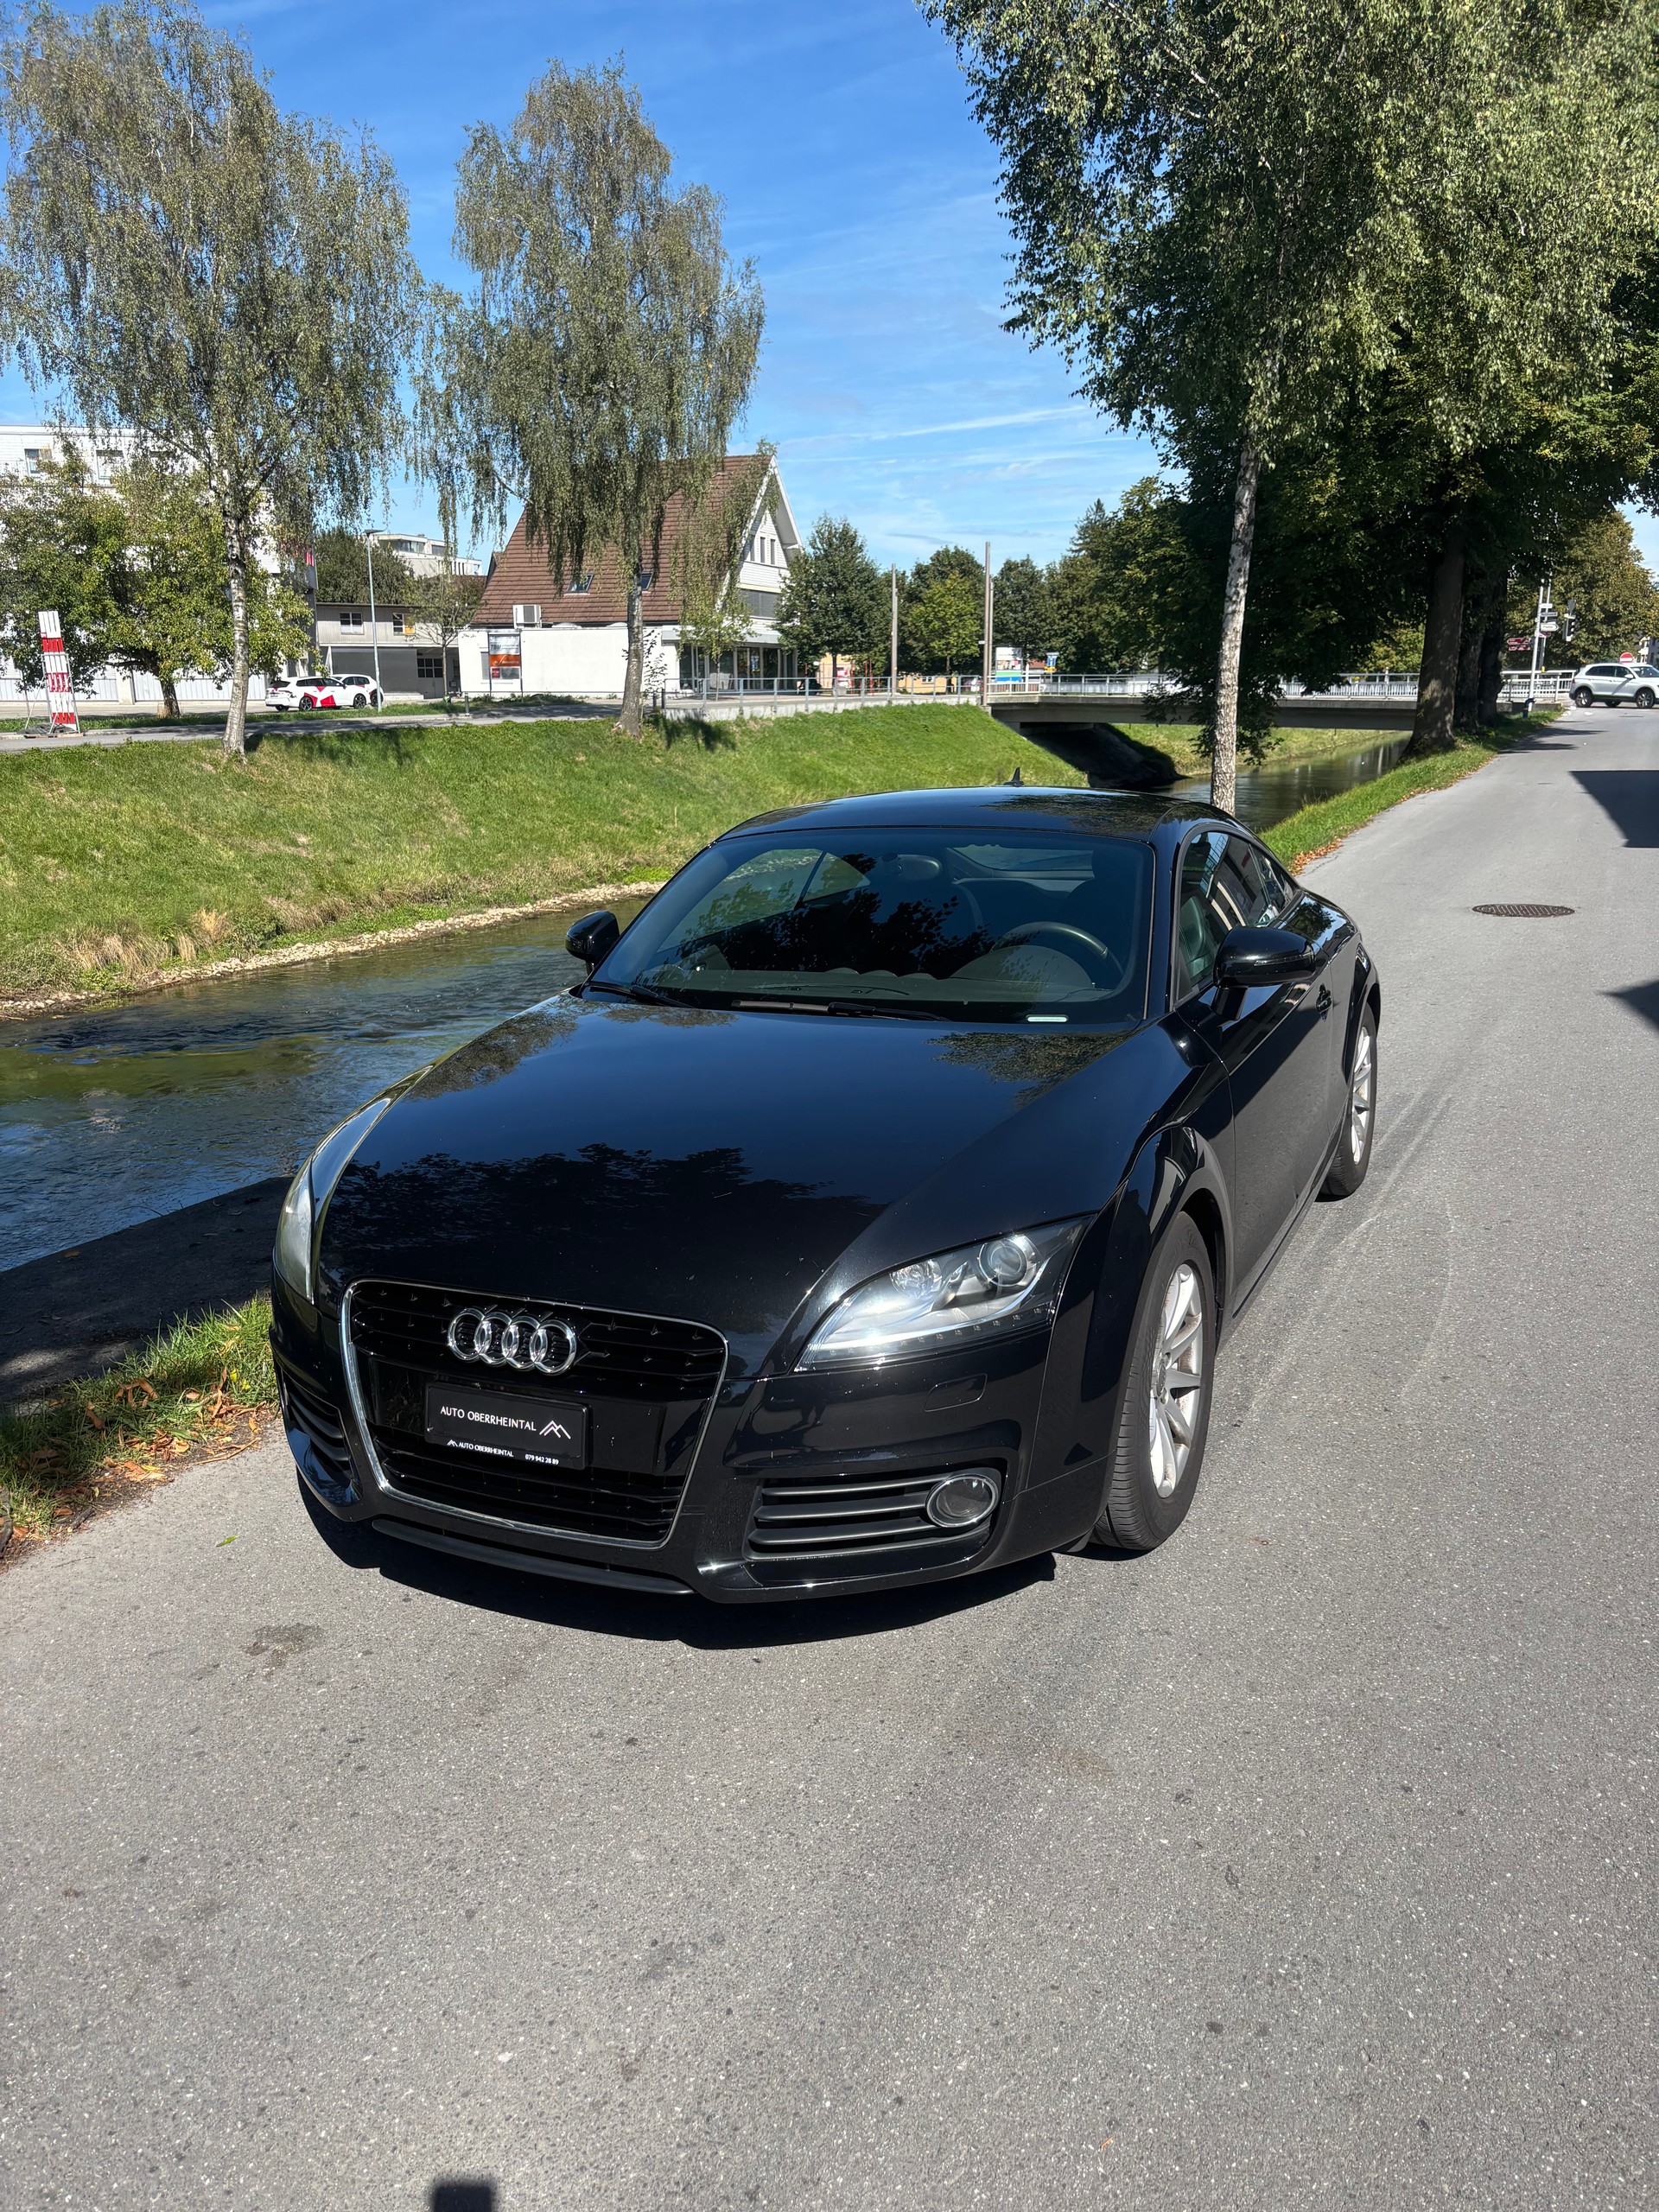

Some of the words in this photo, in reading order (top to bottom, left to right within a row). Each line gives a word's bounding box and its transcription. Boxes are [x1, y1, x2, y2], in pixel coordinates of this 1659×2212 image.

[440, 1406, 465, 1419] AUTO
[467, 1411, 537, 1431] OBERRHEINTAL
[458, 1441, 474, 1450] AUTO
[474, 1445, 514, 1458] OBERRHEINTAL
